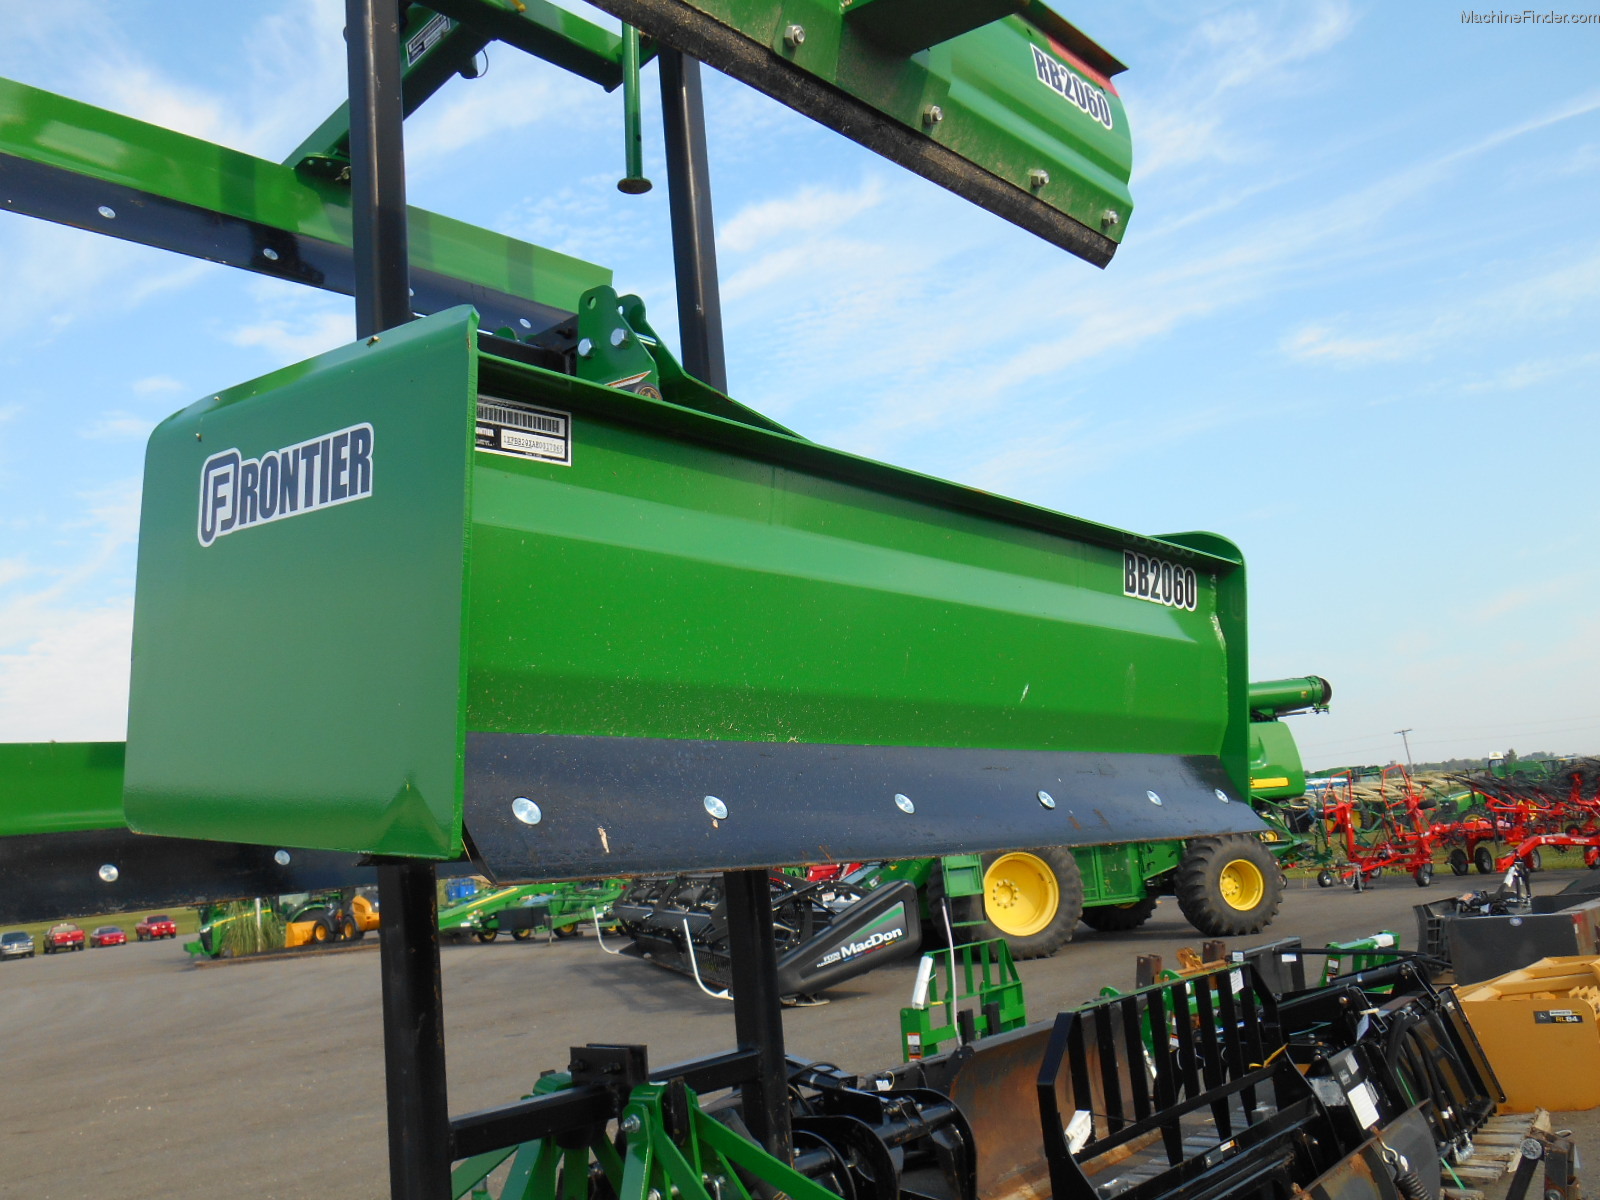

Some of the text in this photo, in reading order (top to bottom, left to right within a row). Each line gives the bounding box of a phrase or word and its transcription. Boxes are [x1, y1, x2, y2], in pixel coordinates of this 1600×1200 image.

[1031, 43, 1112, 128] RB2060
[199, 424, 373, 545] FRONTIER
[1124, 550, 1197, 611] BB2060
[841, 928, 902, 958] MacDon
